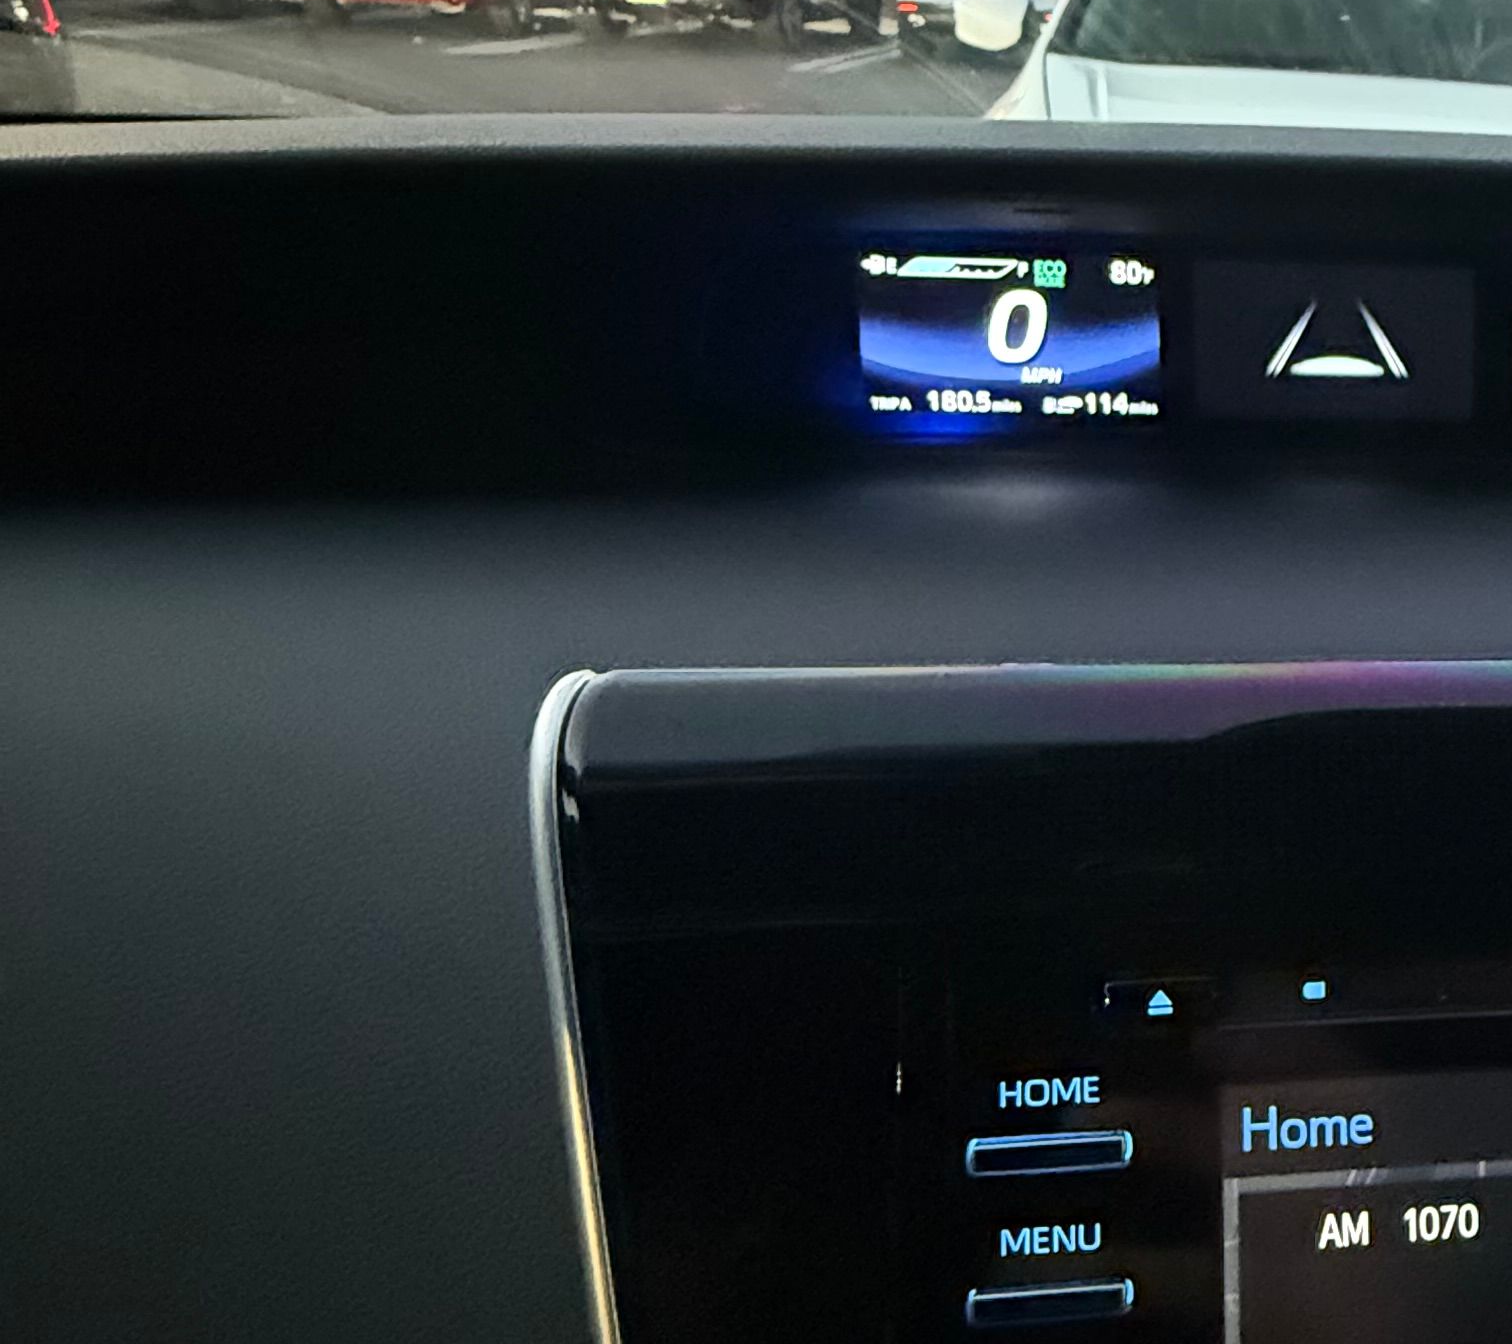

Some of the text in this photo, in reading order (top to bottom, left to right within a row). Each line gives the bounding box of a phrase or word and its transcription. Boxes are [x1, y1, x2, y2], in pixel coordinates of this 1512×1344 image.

[1033, 259, 1067, 275] ECO
[988, 288, 1049, 365] 0
[1020, 366, 1064, 385] MPH
[999, 1075, 1100, 1109] HOME
[1242, 1105, 1374, 1152] Home
[1000, 1223, 1101, 1257] MENU
[1318, 1202, 1480, 1250] AM 1070
